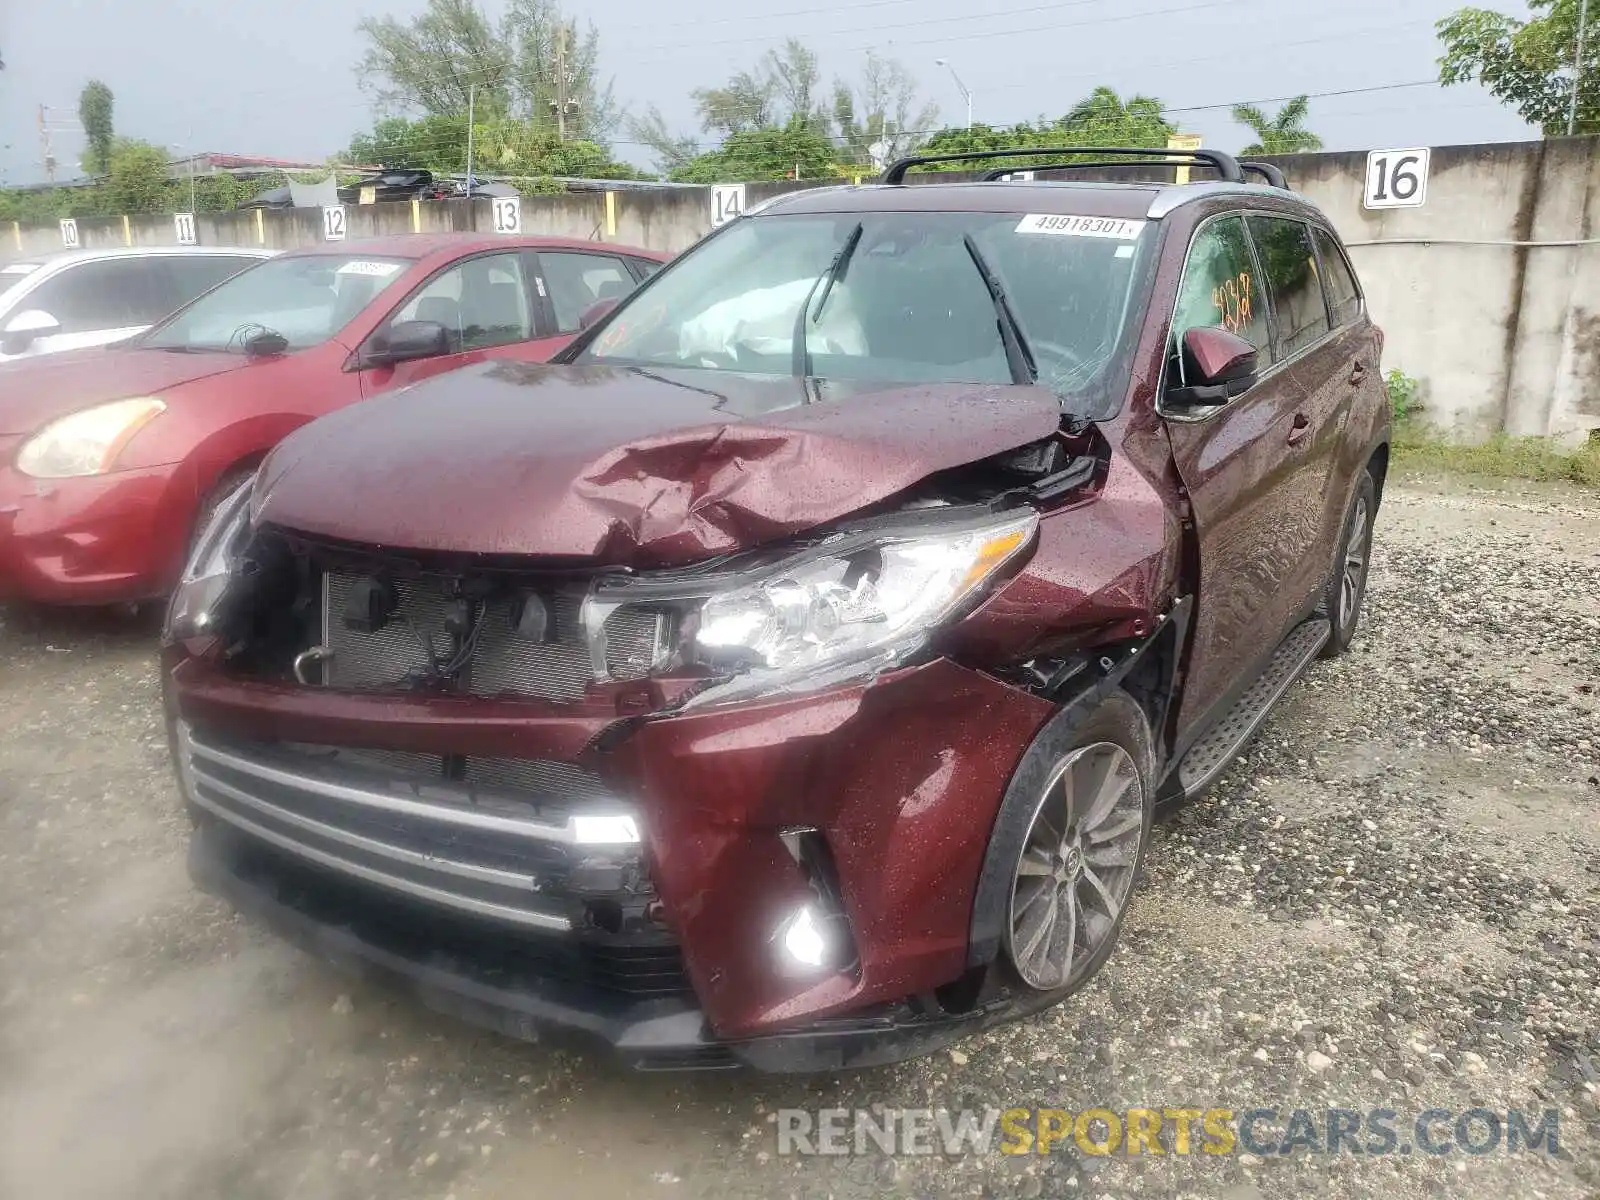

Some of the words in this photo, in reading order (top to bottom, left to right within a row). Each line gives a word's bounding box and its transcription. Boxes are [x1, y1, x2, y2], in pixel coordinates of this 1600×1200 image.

[1373, 156, 1419, 200] 16
[496, 202, 517, 231] 13
[715, 190, 741, 221] 14
[63, 222, 76, 243] 10
[178, 217, 193, 241] 11
[326, 210, 343, 235] 12
[1035, 216, 1126, 234] 49918301
